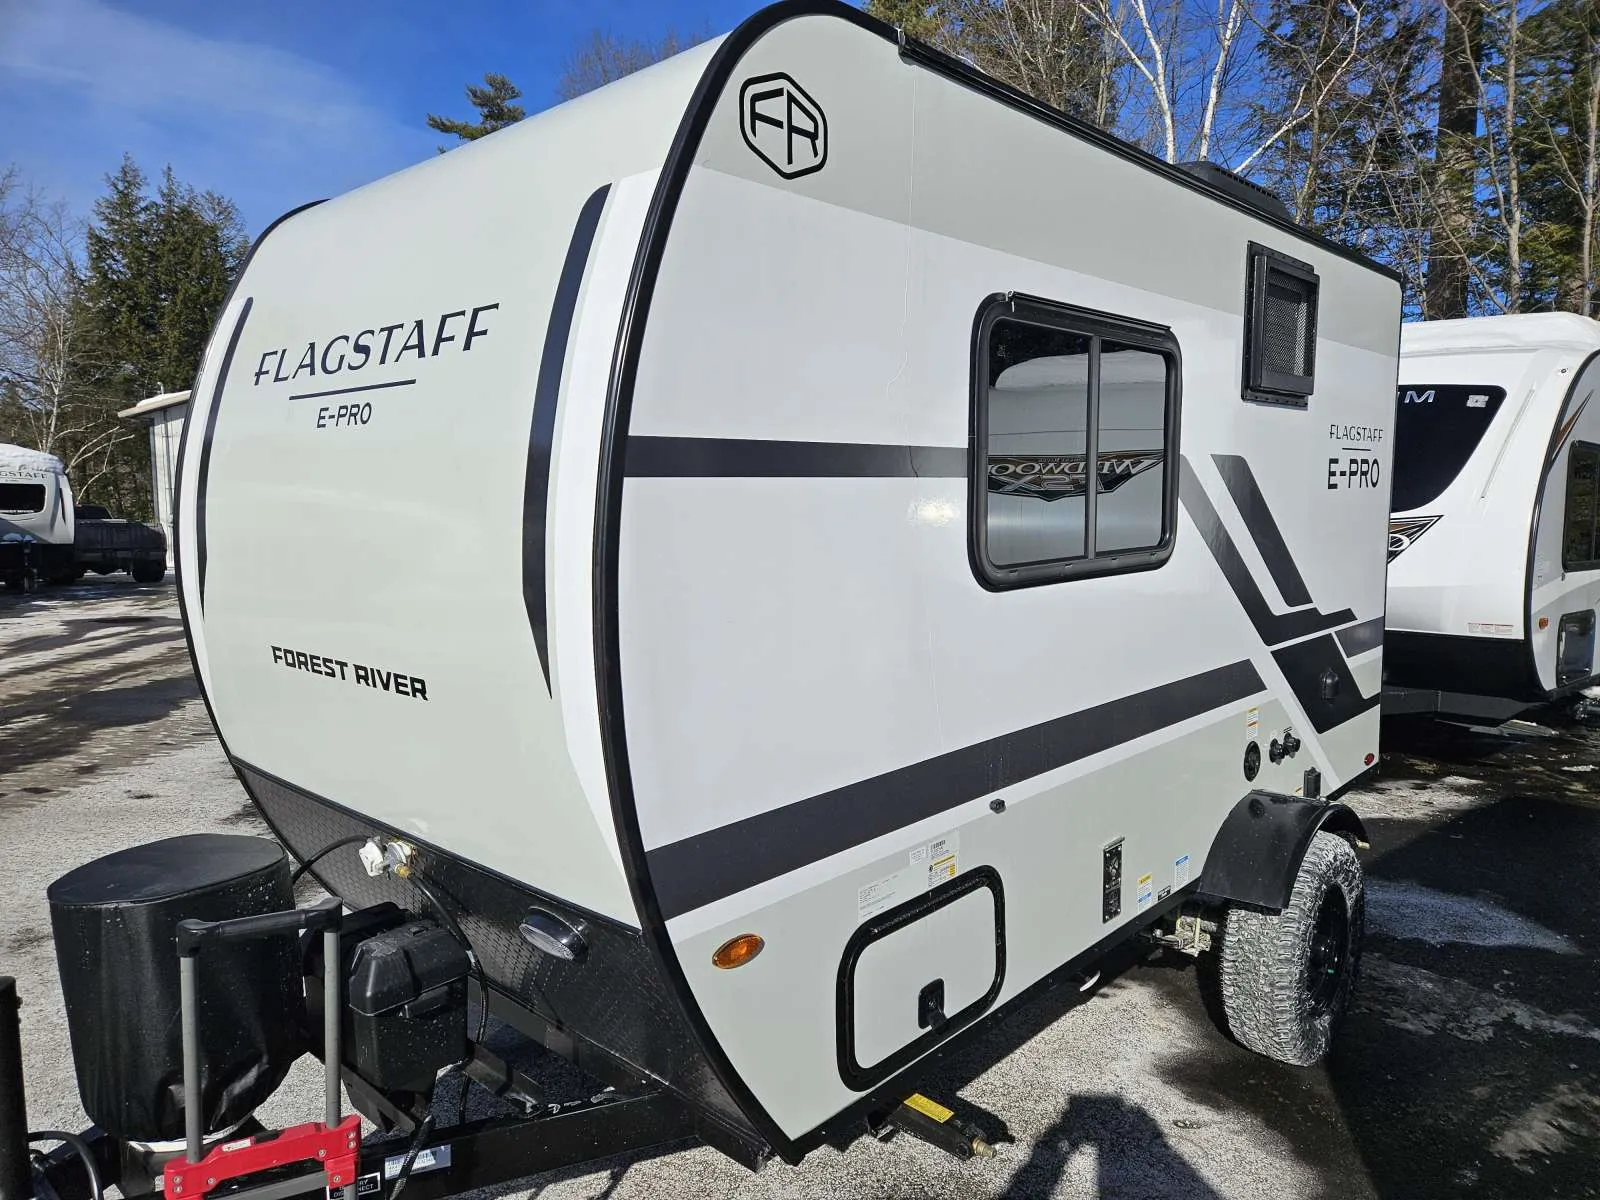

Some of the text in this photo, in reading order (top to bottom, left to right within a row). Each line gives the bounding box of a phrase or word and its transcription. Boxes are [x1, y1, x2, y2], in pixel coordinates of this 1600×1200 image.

[254, 302, 500, 386] FLAGSTAFF
[316, 402, 373, 428] E-PRO
[1329, 424, 1384, 442] FLAGSTAFF
[1327, 458, 1380, 490] E-PRO
[270, 645, 429, 701] FOREST RIVER
